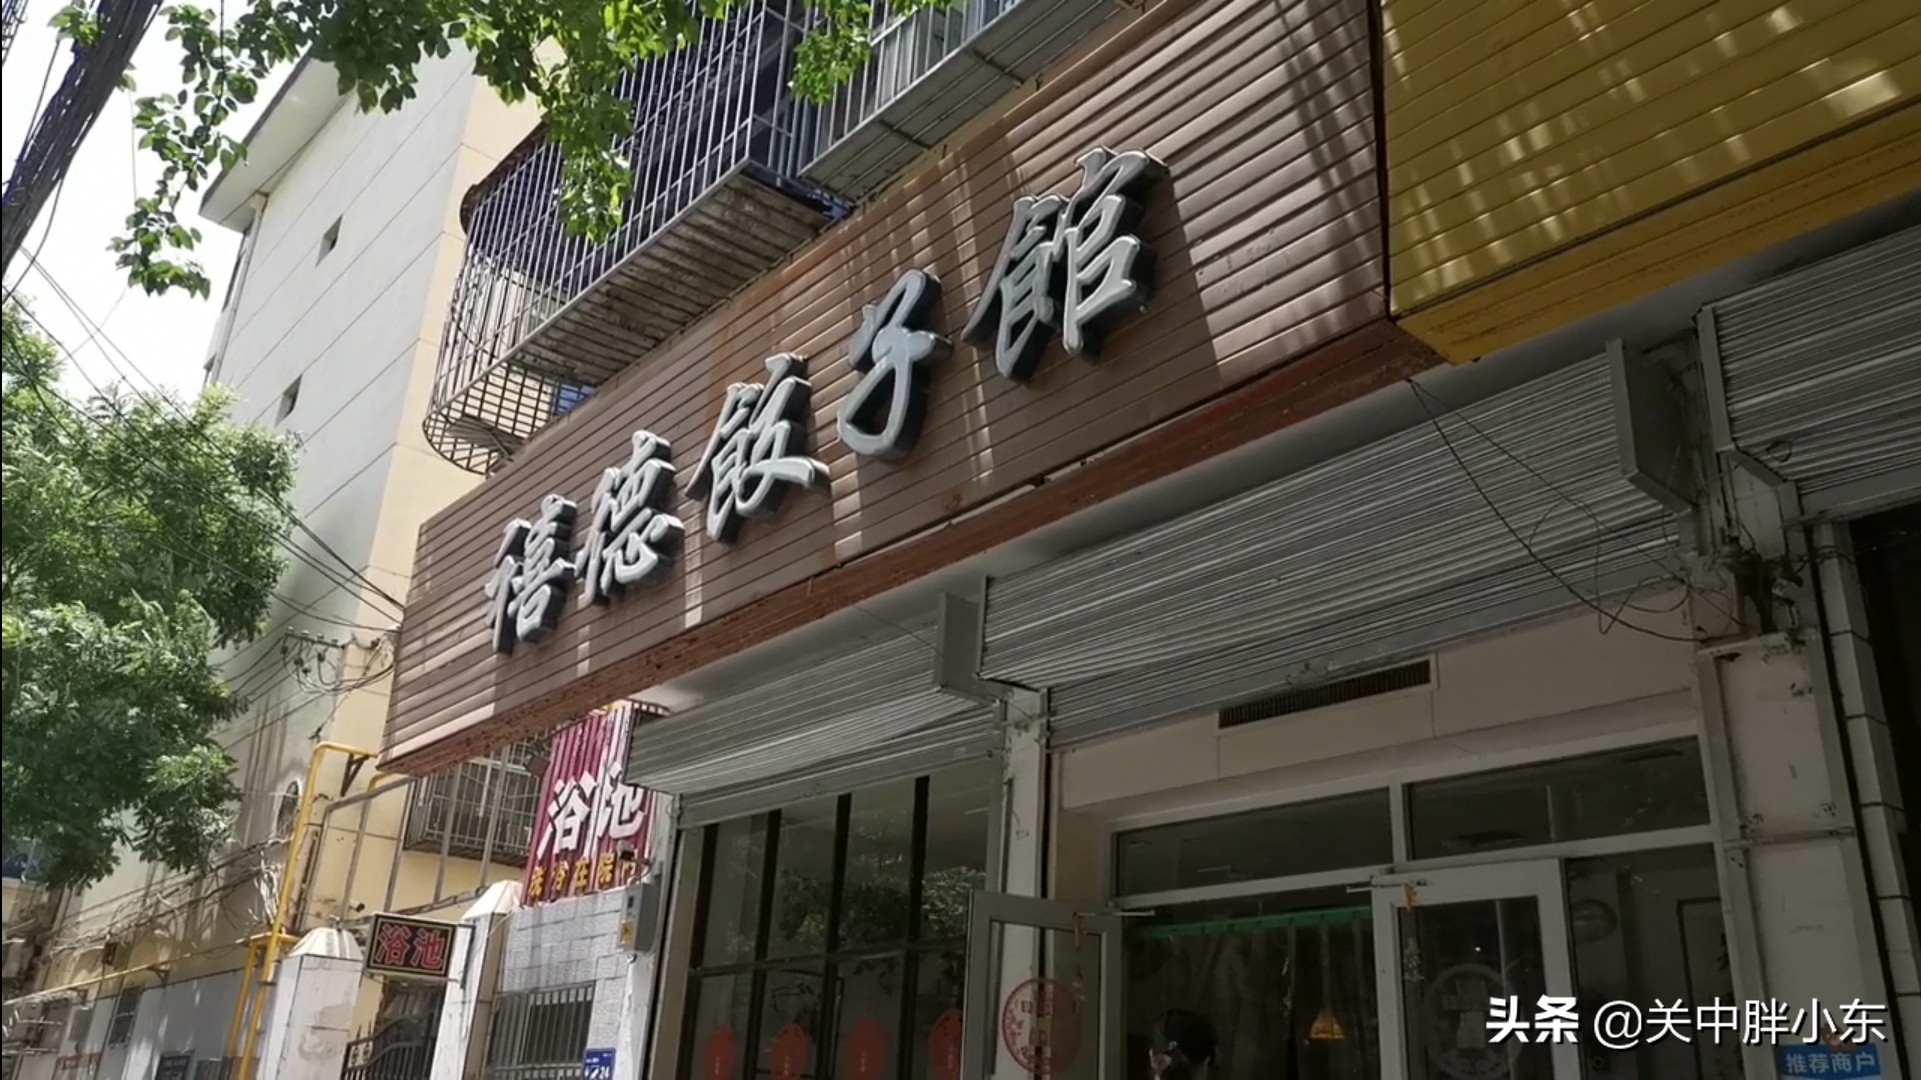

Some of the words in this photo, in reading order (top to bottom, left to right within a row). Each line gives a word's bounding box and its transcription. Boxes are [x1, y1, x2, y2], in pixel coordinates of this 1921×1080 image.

[537, 762, 647, 860] 浴池
[375, 923, 445, 969] 浴池
[1785, 1051, 1877, 1073] 推荐商户
